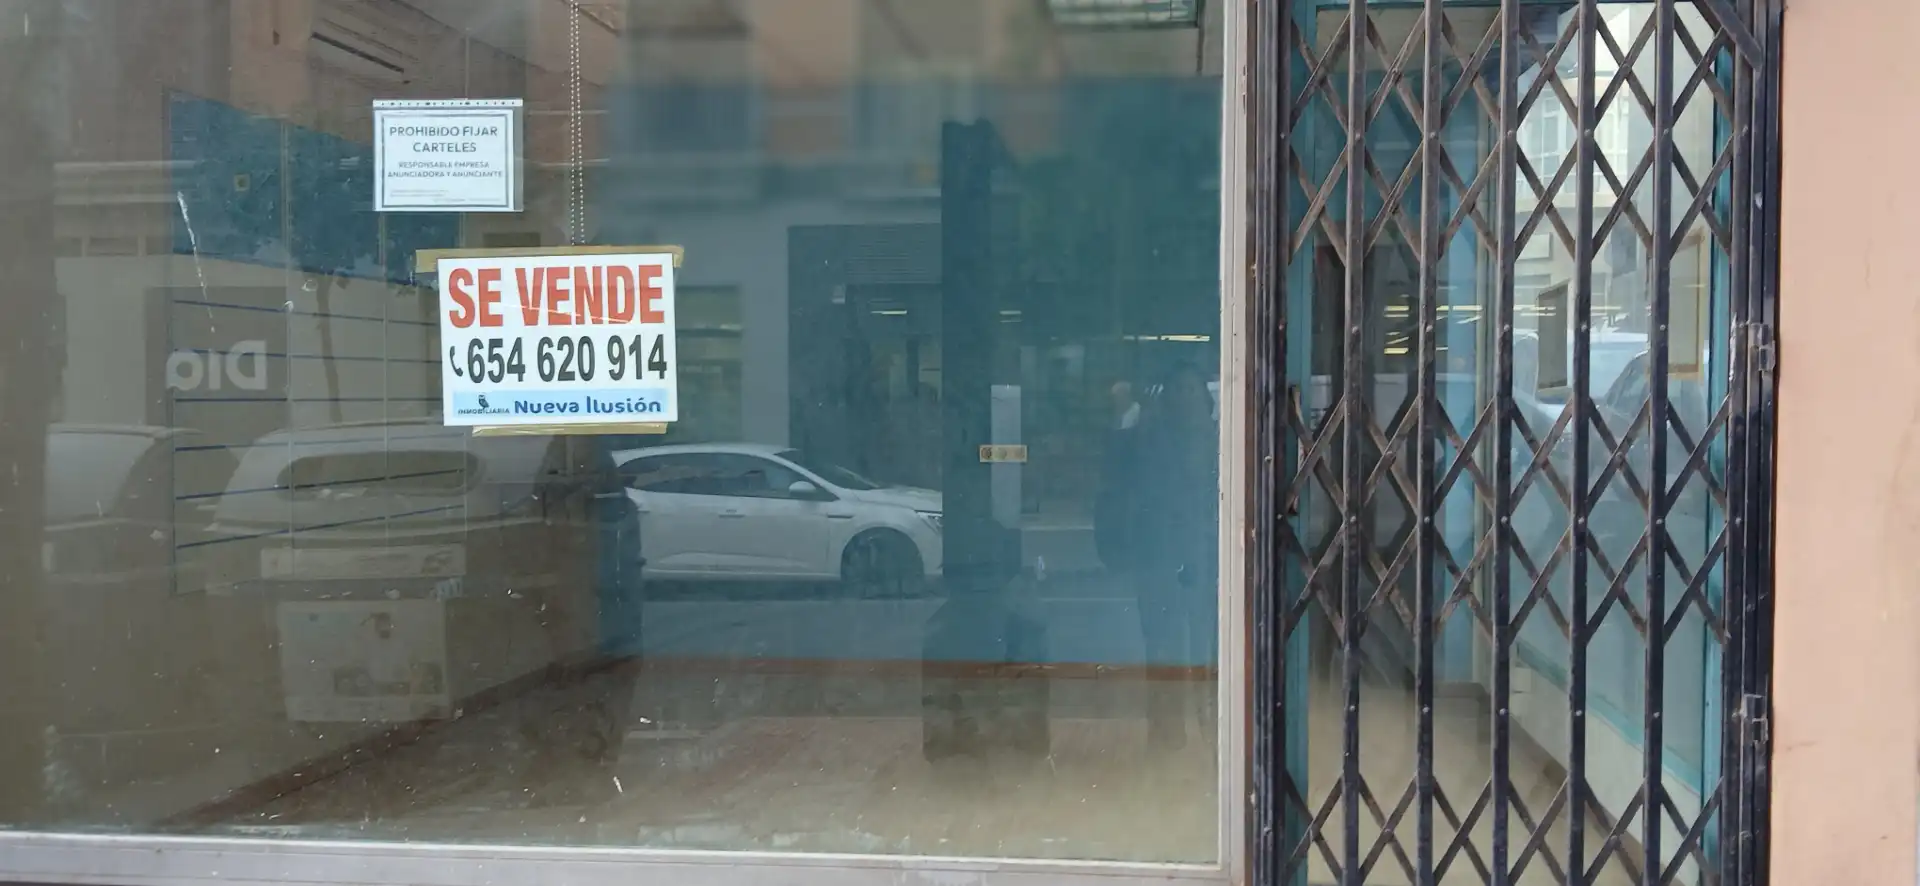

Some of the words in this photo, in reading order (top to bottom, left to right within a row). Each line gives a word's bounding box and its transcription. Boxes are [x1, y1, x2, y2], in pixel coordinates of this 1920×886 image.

[389, 126, 460, 137] PROHIBIDO
[462, 126, 498, 137] FIJAR
[412, 142, 477, 153] CARTELES
[448, 267, 503, 329] SE
[515, 264, 665, 327] VENDE
[467, 337, 526, 384] 654
[537, 335, 596, 383] 620
[607, 334, 668, 381] 914
[457, 407, 510, 415] INMOBILIARIA
[514, 399, 580, 414] Nueva
[586, 395, 662, 414] Ilusión
